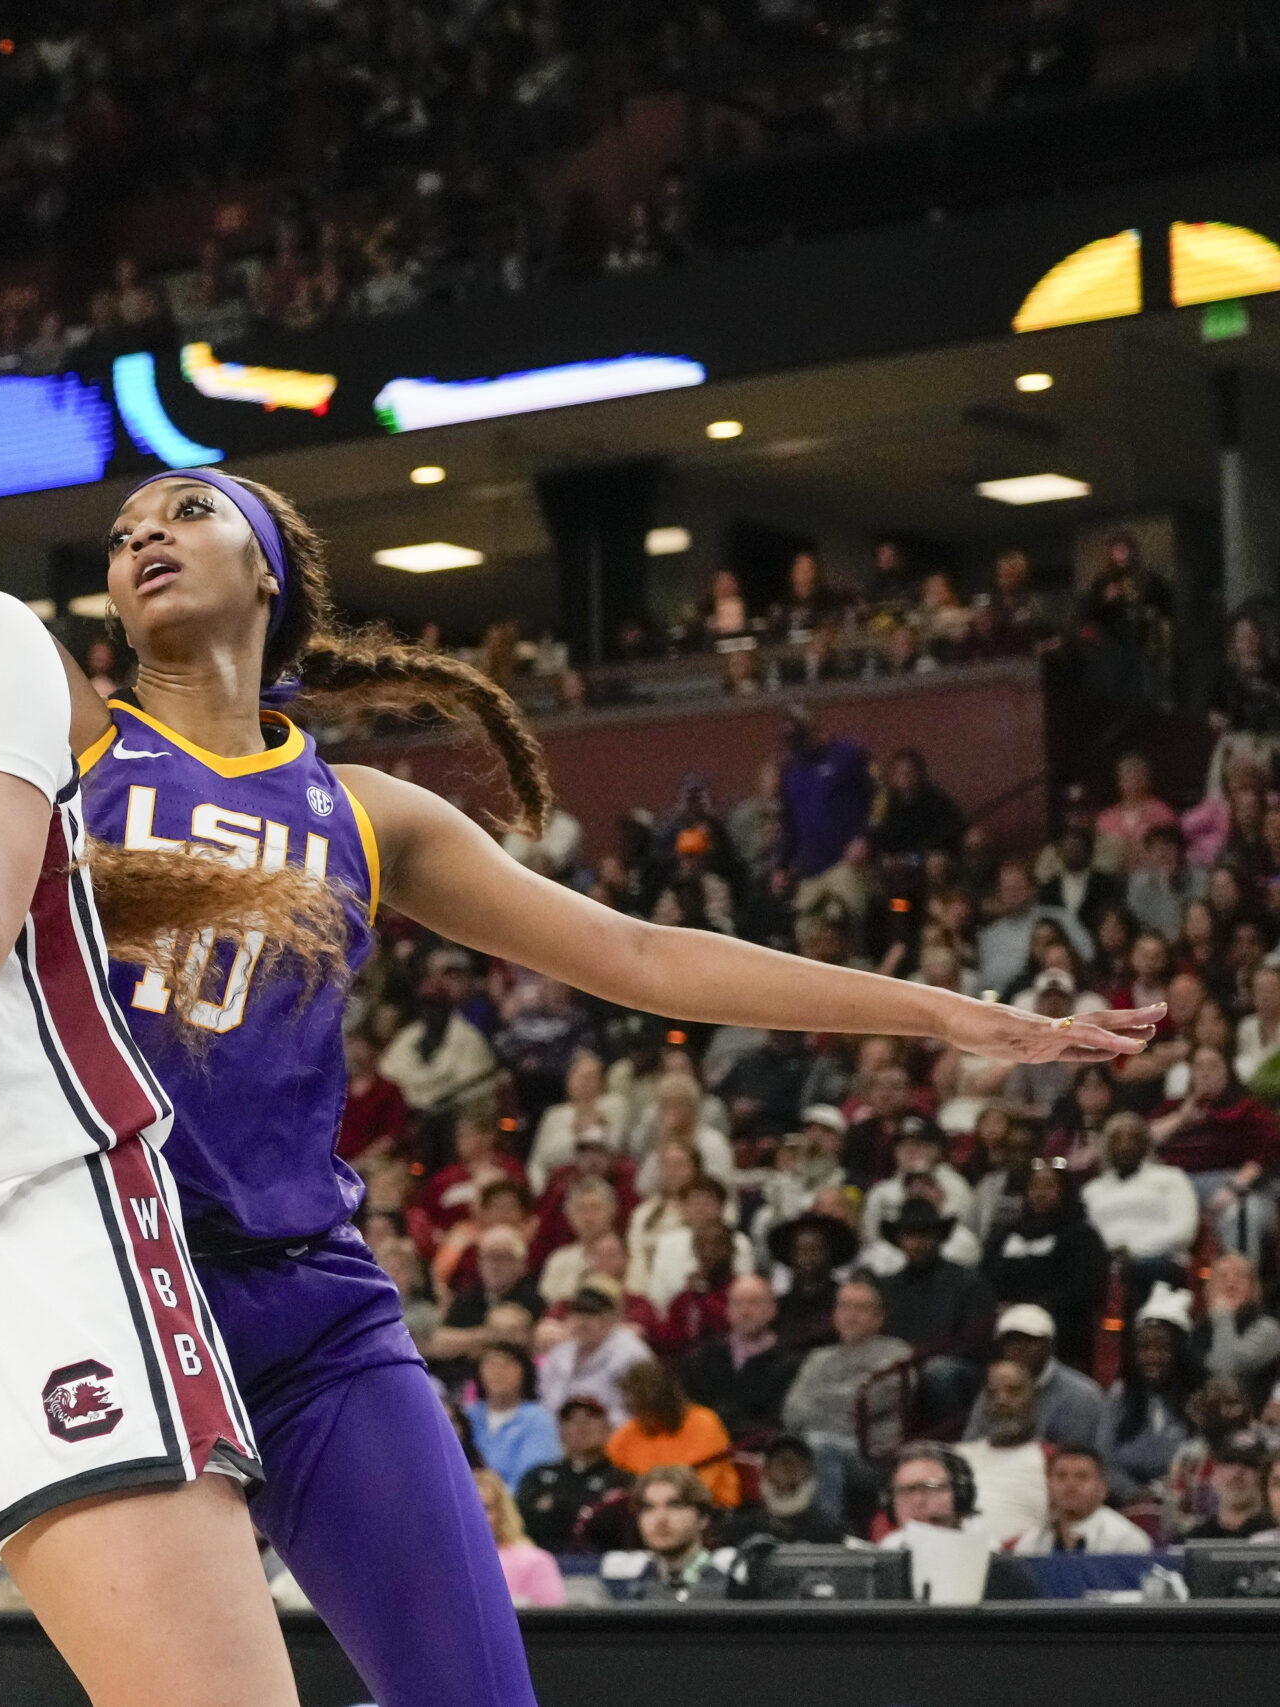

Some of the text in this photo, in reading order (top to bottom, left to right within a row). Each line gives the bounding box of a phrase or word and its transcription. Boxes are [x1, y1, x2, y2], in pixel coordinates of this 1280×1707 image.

[124, 784, 329, 882] LSU
[308, 787, 332, 815] SEC
[133, 915, 266, 1034] 10
